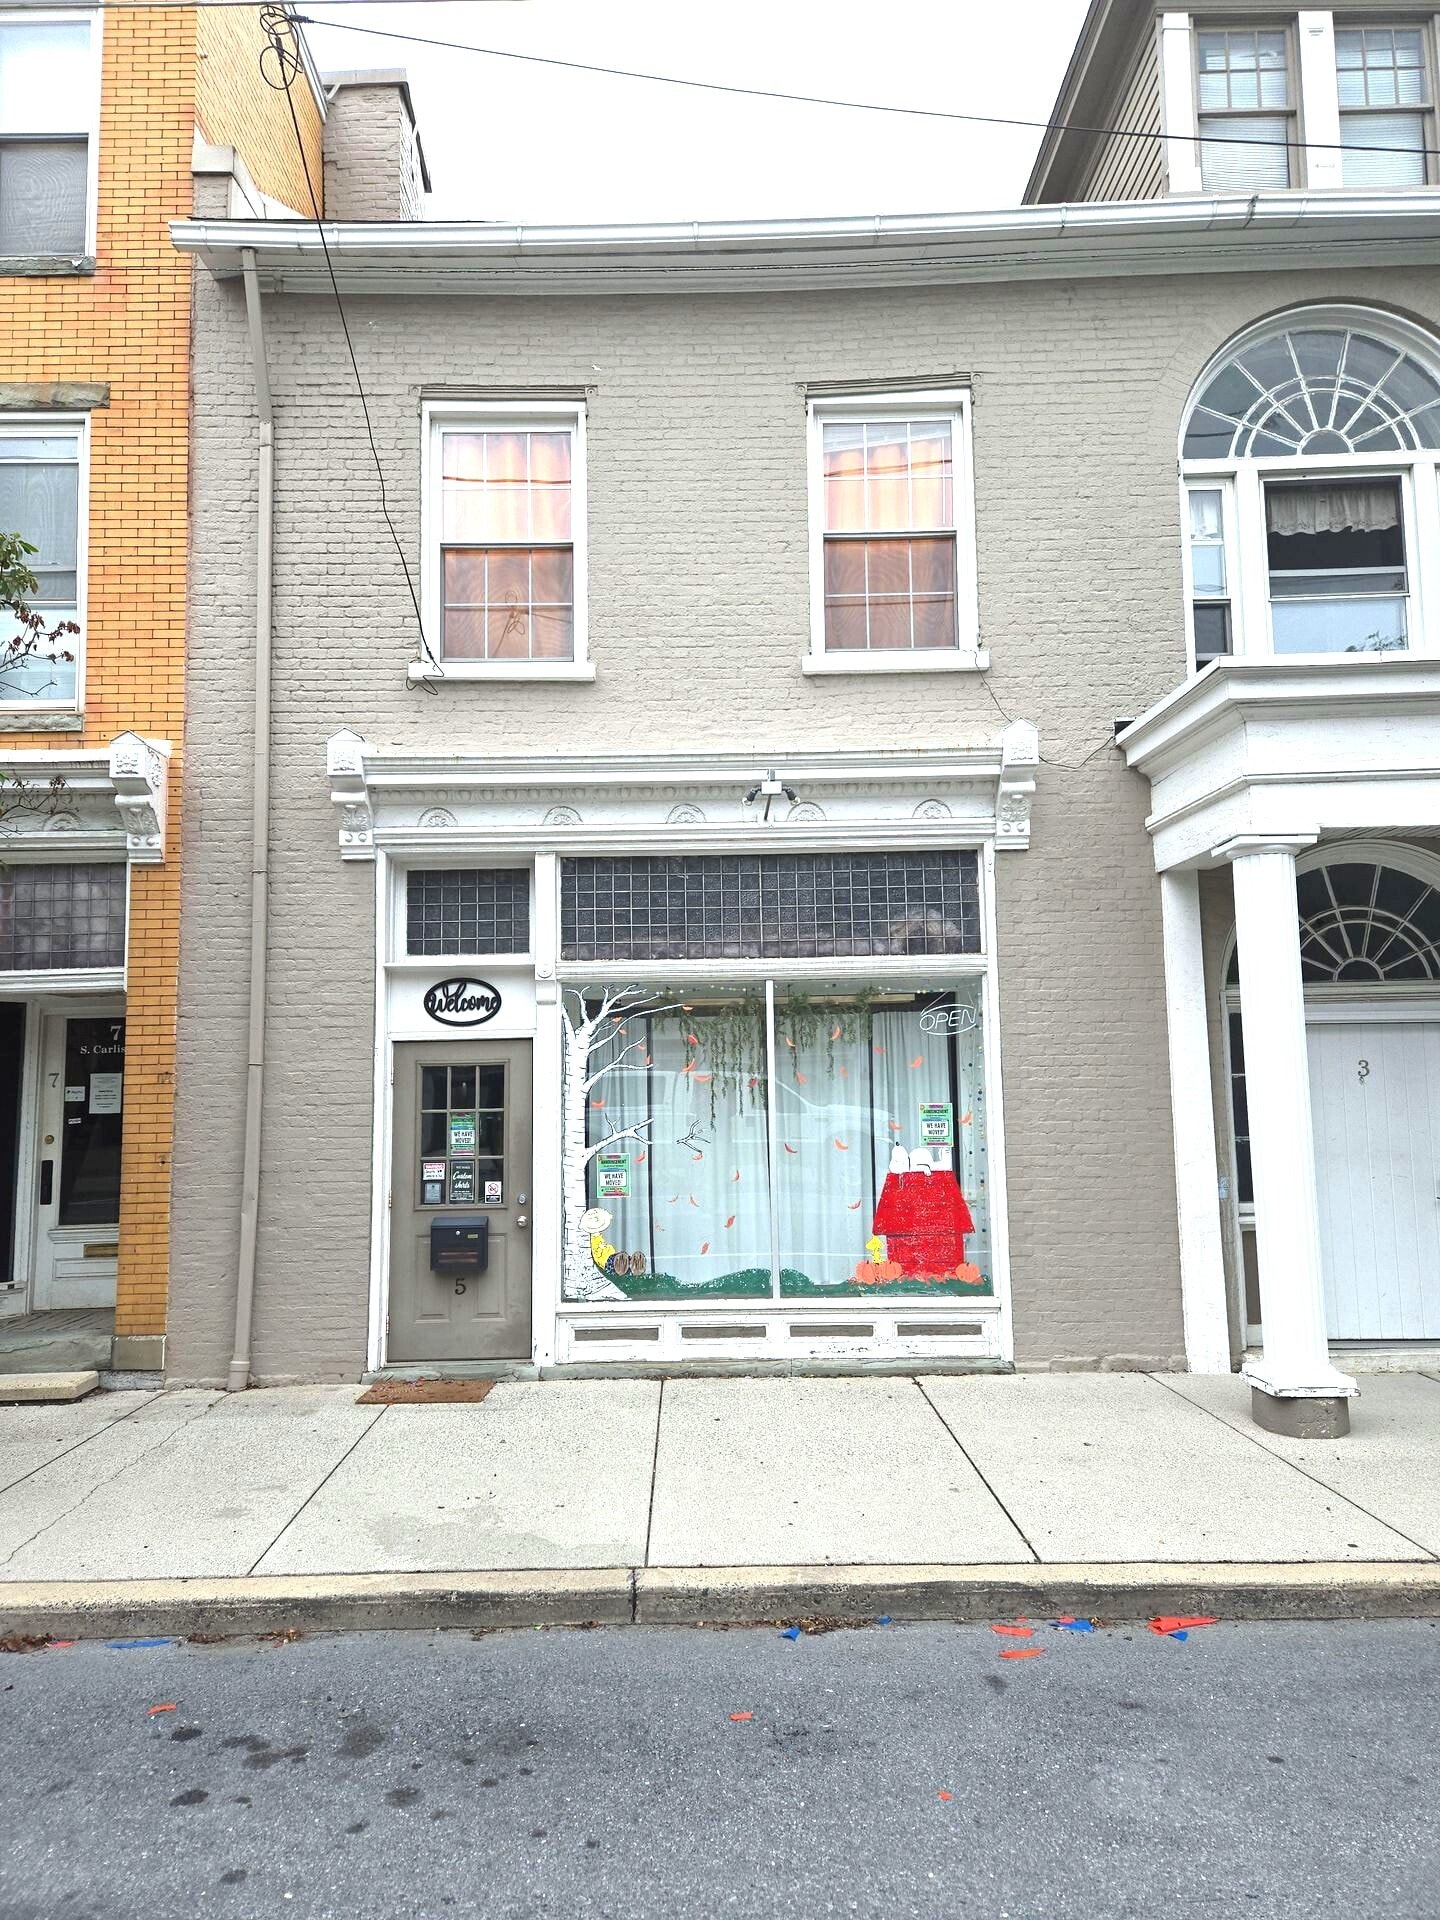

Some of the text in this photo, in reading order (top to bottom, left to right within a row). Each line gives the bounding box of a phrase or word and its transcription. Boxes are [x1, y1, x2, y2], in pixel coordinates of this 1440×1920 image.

[427, 982, 499, 1013] Welcome
[919, 1009, 976, 1031] OPEN
[110, 1025, 122, 1041] 7
[80, 1045, 91, 1056] S.
[1357, 1059, 1370, 1077] 3
[48, 1072, 60, 1089] 7
[454, 1277, 466, 1295] 5
